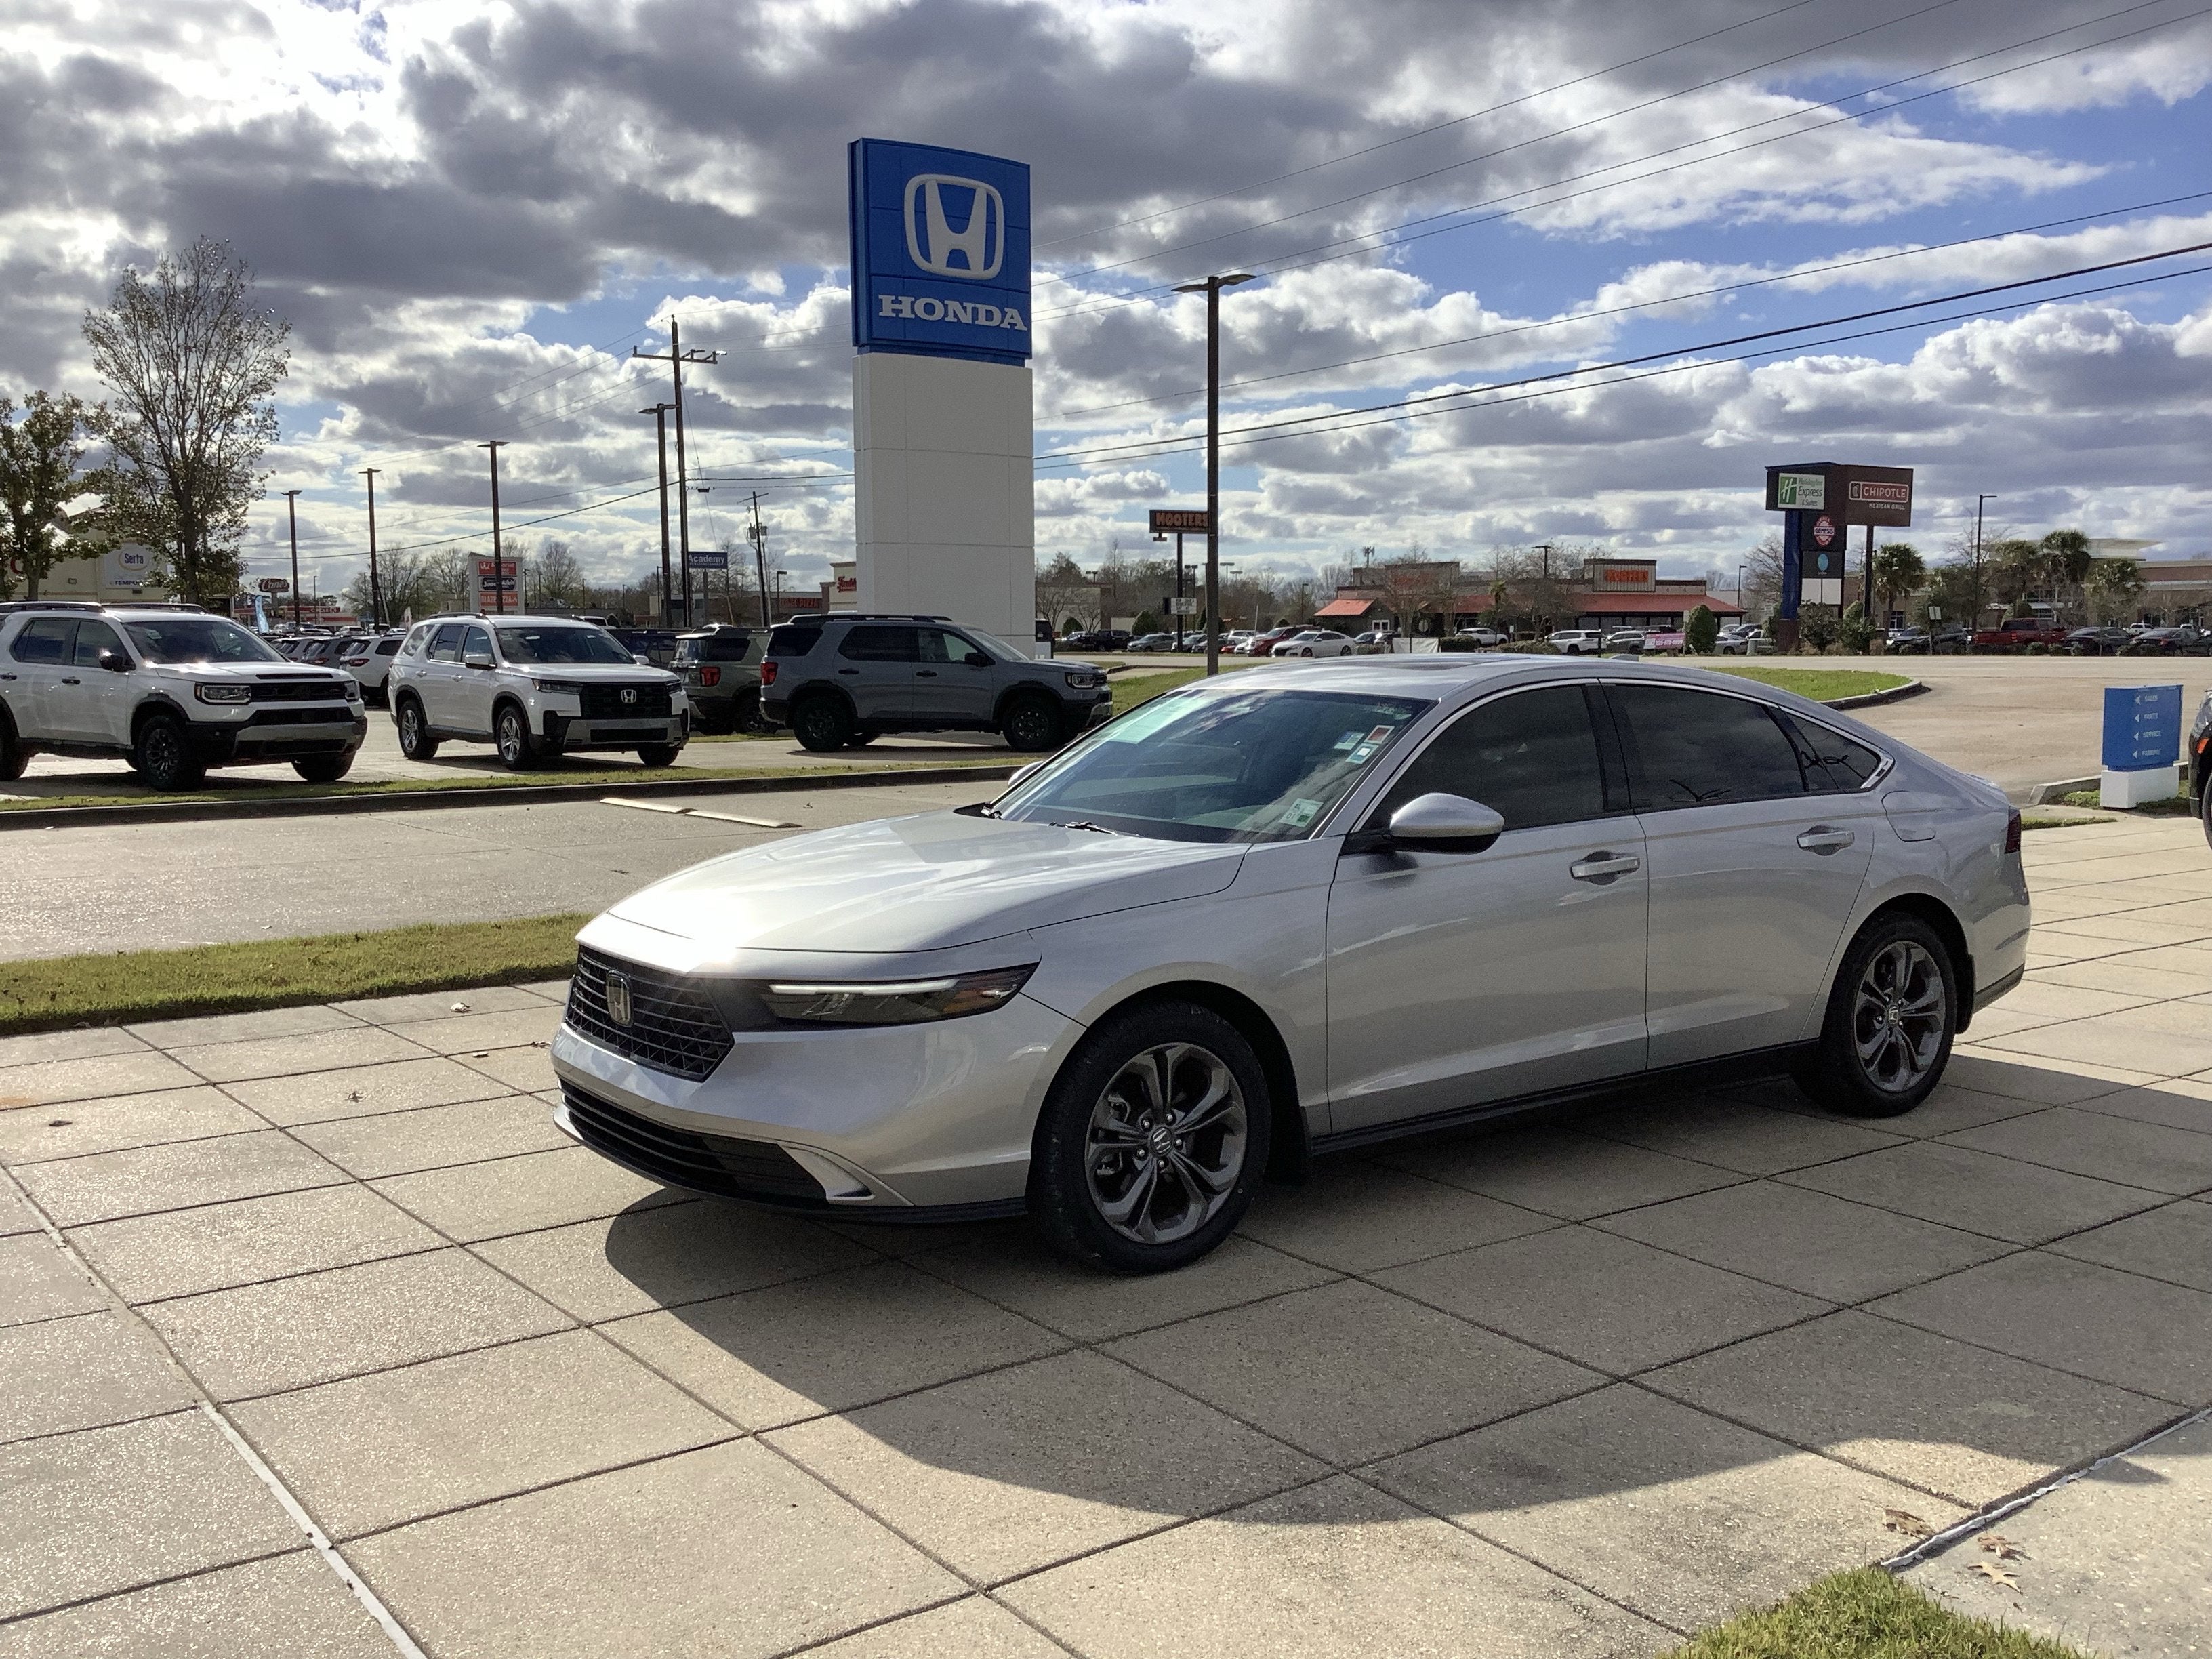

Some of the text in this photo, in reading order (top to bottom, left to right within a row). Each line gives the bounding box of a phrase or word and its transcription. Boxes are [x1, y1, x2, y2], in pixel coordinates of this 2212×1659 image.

[878, 294, 1028, 331] HONDA
[1798, 486, 1823, 498] Express
[1863, 487, 1906, 498] CHIPOTLE
[1155, 512, 1208, 527] HOOTERS
[125, 553, 144, 565] Serta
[689, 554, 725, 565] Academy
